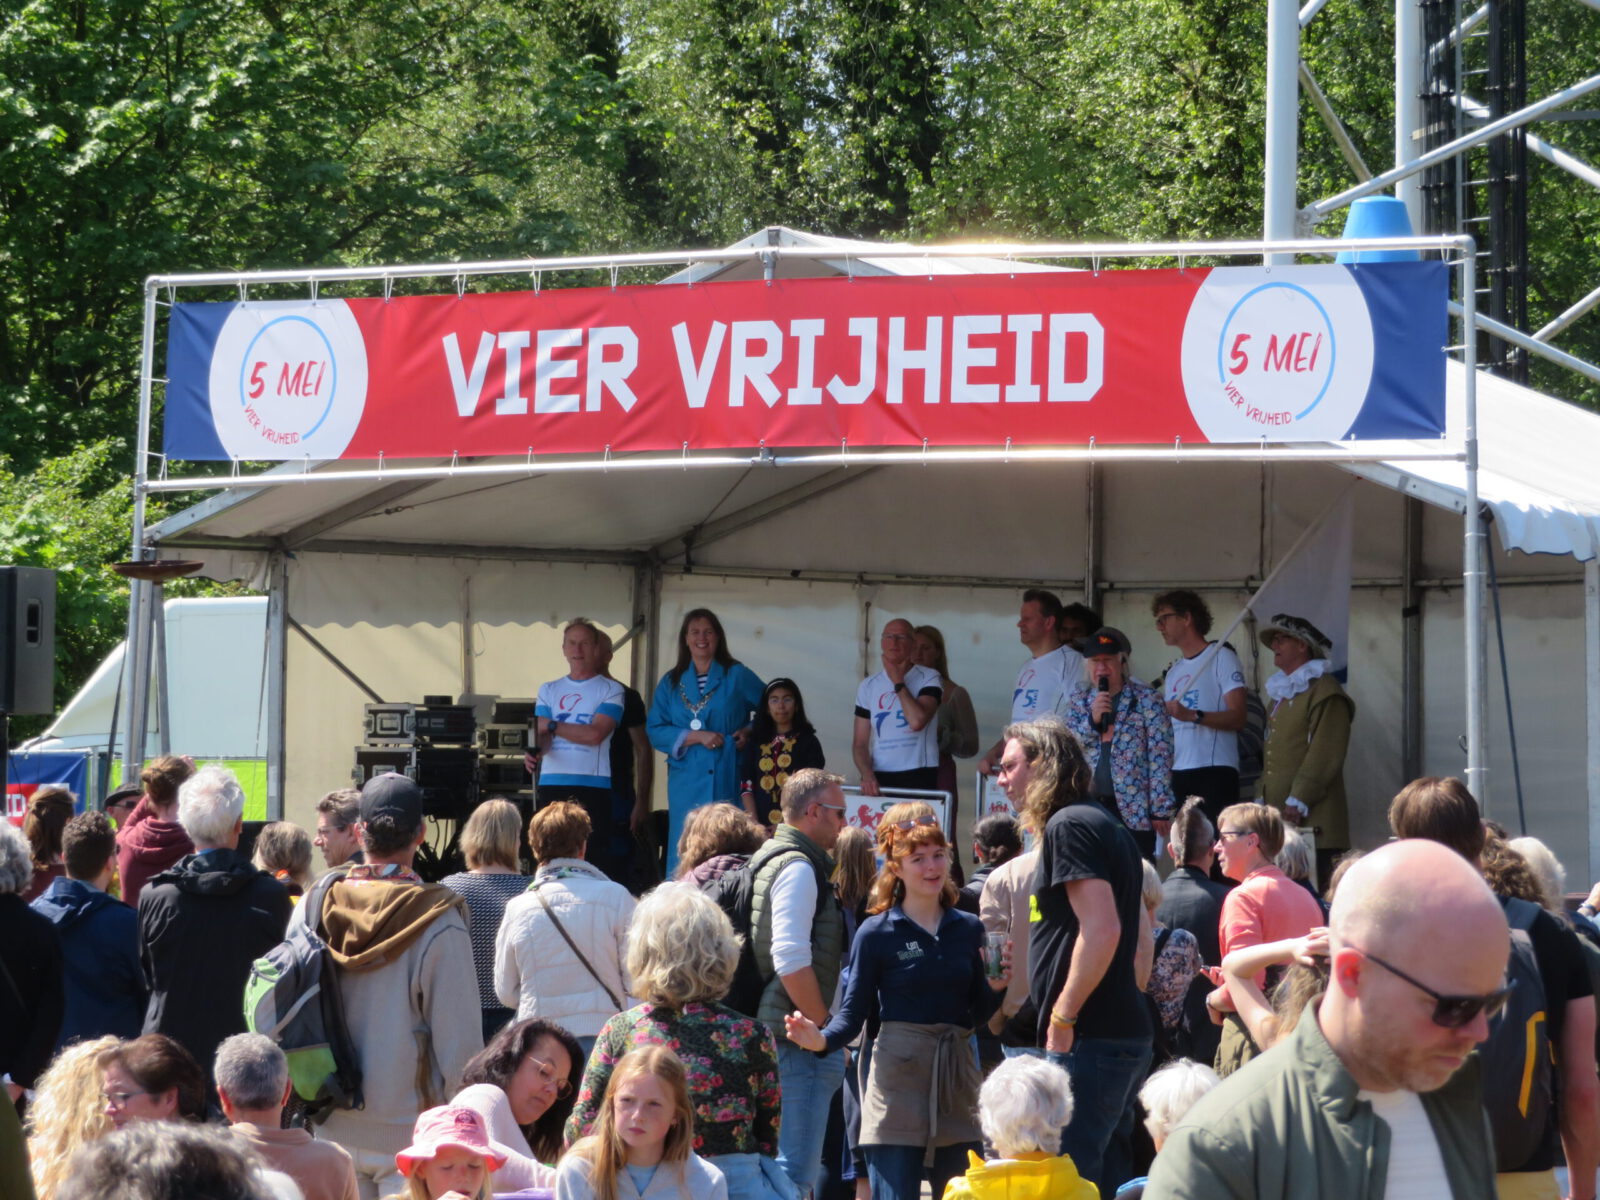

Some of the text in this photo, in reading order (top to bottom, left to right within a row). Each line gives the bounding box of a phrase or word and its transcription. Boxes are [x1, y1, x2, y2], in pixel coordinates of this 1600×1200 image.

[441, 312, 1105, 417] VIER VRIJHEID
[1229, 332, 1322, 375] 5 MEI
[249, 360, 326, 399] 5 MEI
[244, 402, 300, 445] VIER VRIJHEID
[1224, 380, 1292, 425] VIER VRIJHEID
